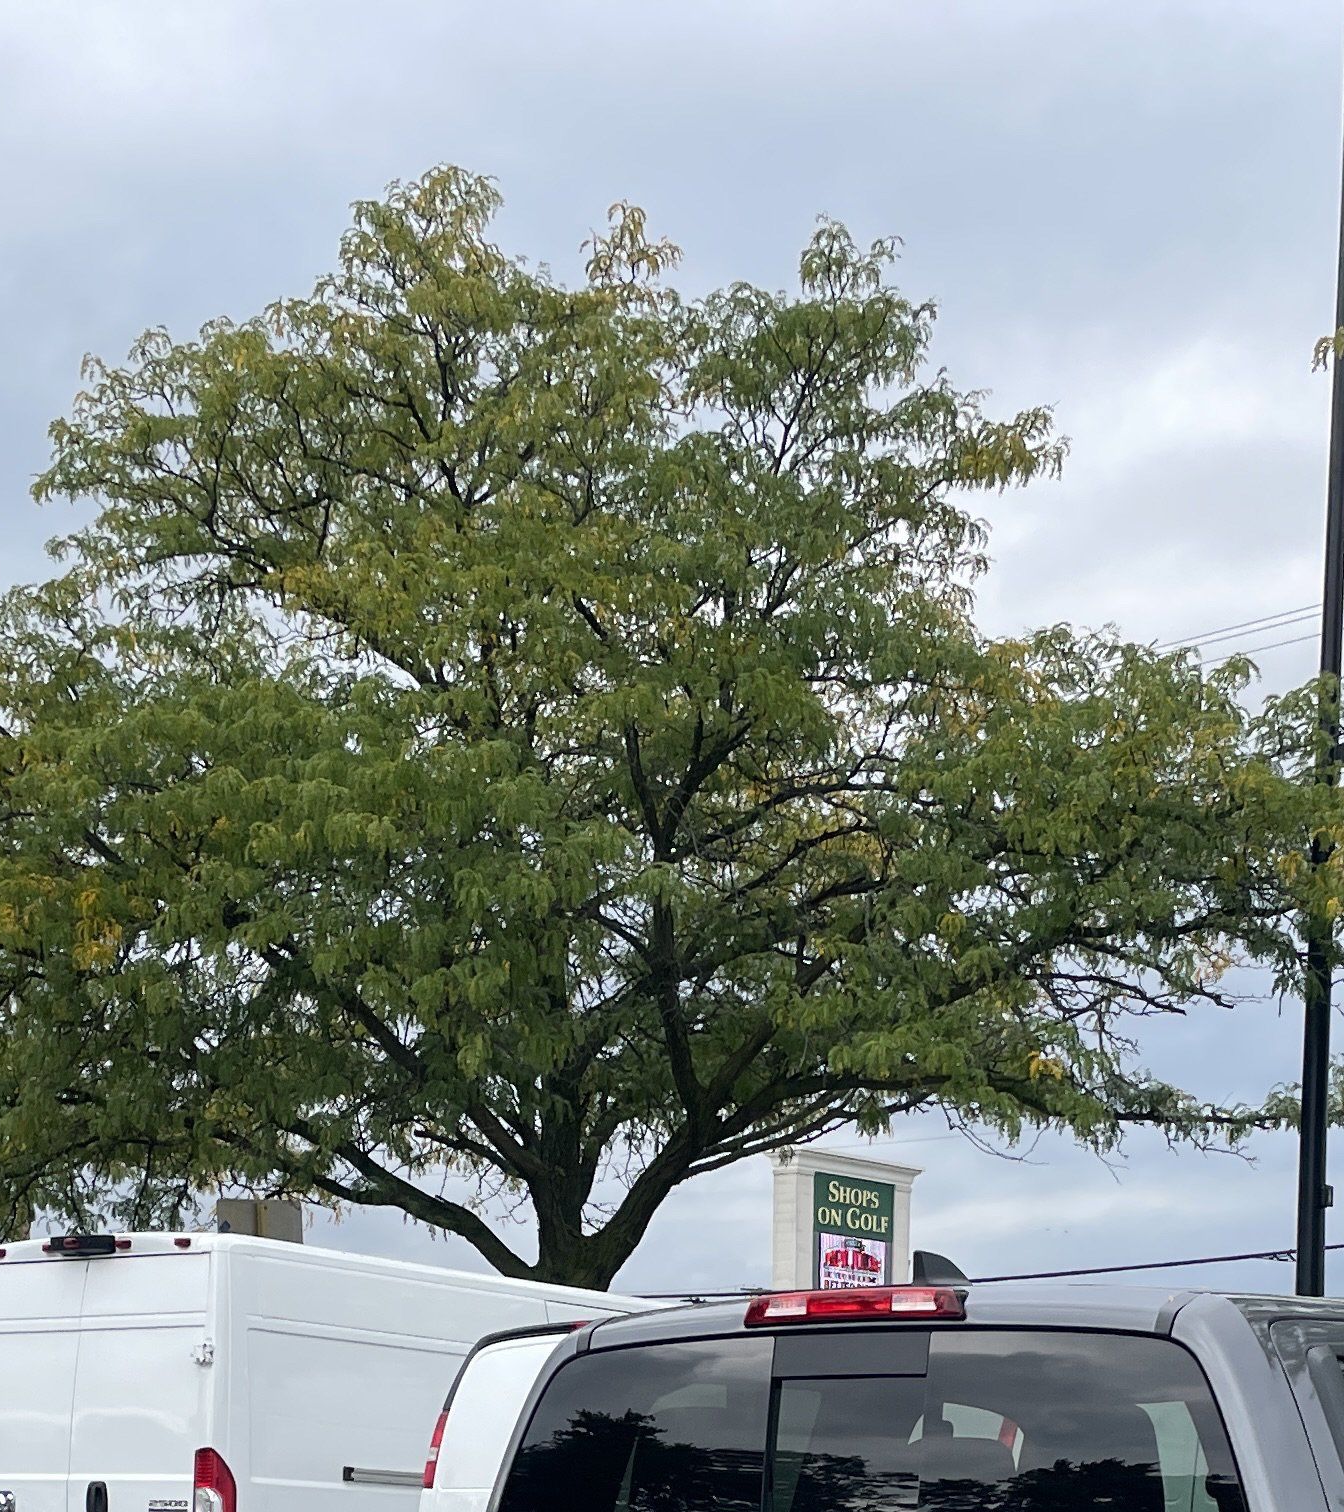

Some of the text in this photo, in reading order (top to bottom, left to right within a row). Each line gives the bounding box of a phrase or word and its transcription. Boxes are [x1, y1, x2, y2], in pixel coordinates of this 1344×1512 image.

[828, 1180, 880, 1209] SHOPS
[817, 1206, 889, 1234] ON GOLF
